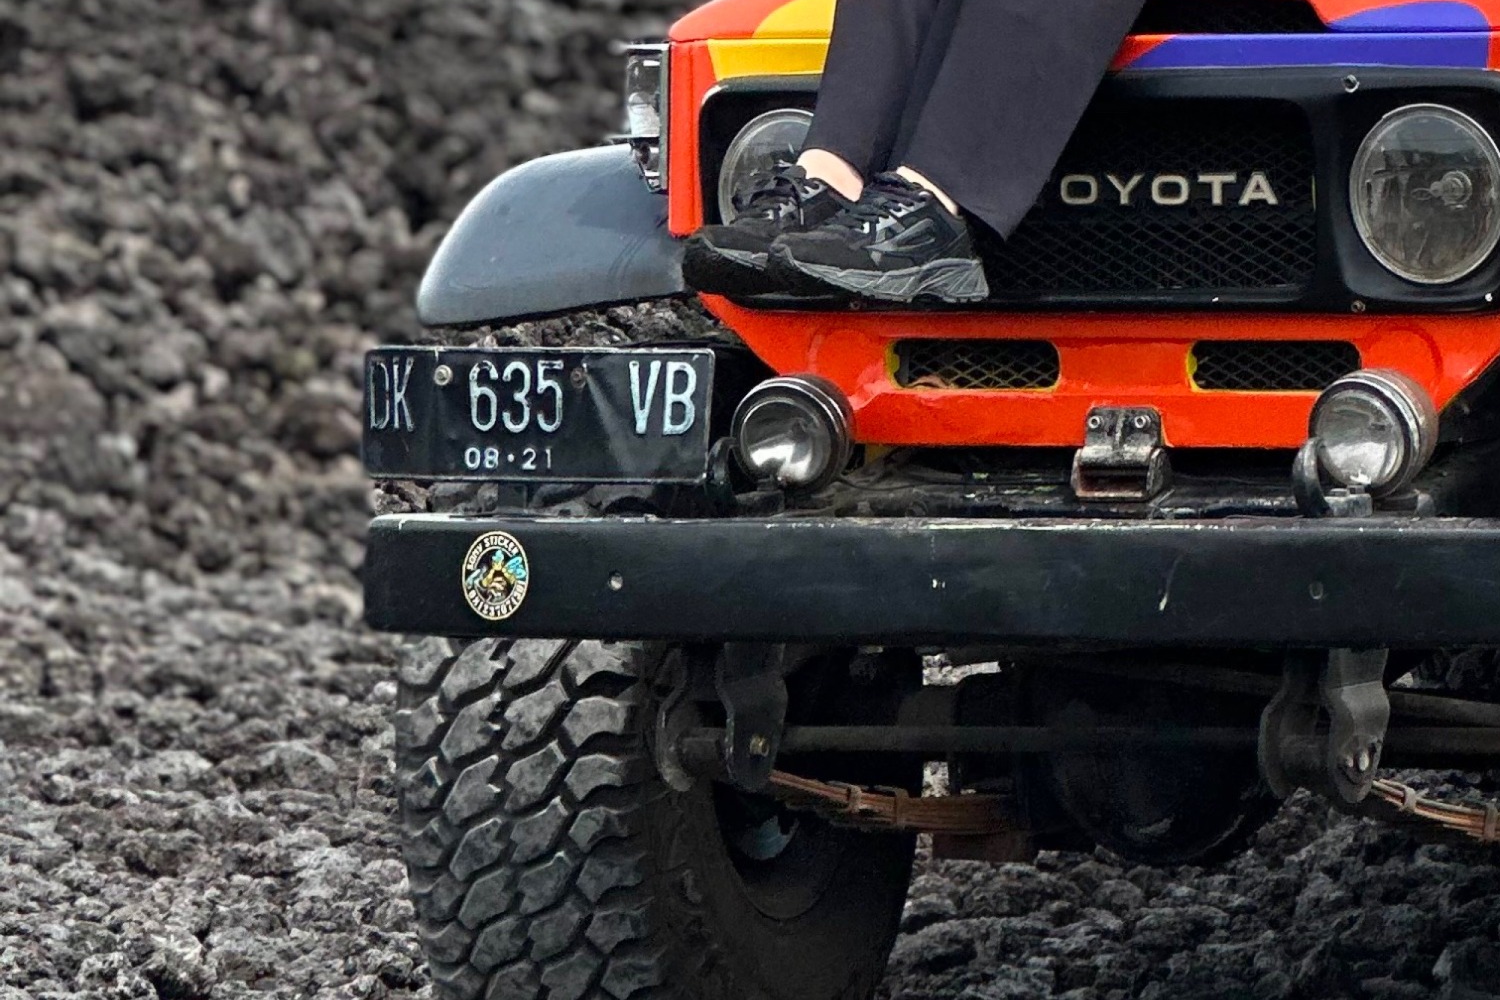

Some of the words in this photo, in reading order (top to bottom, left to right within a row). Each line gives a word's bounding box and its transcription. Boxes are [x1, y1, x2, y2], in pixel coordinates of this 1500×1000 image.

[1060, 171, 1279, 206] OYOTA
[369, 356, 415, 432] DK
[469, 359, 564, 433] 635
[629, 360, 697, 436] VB
